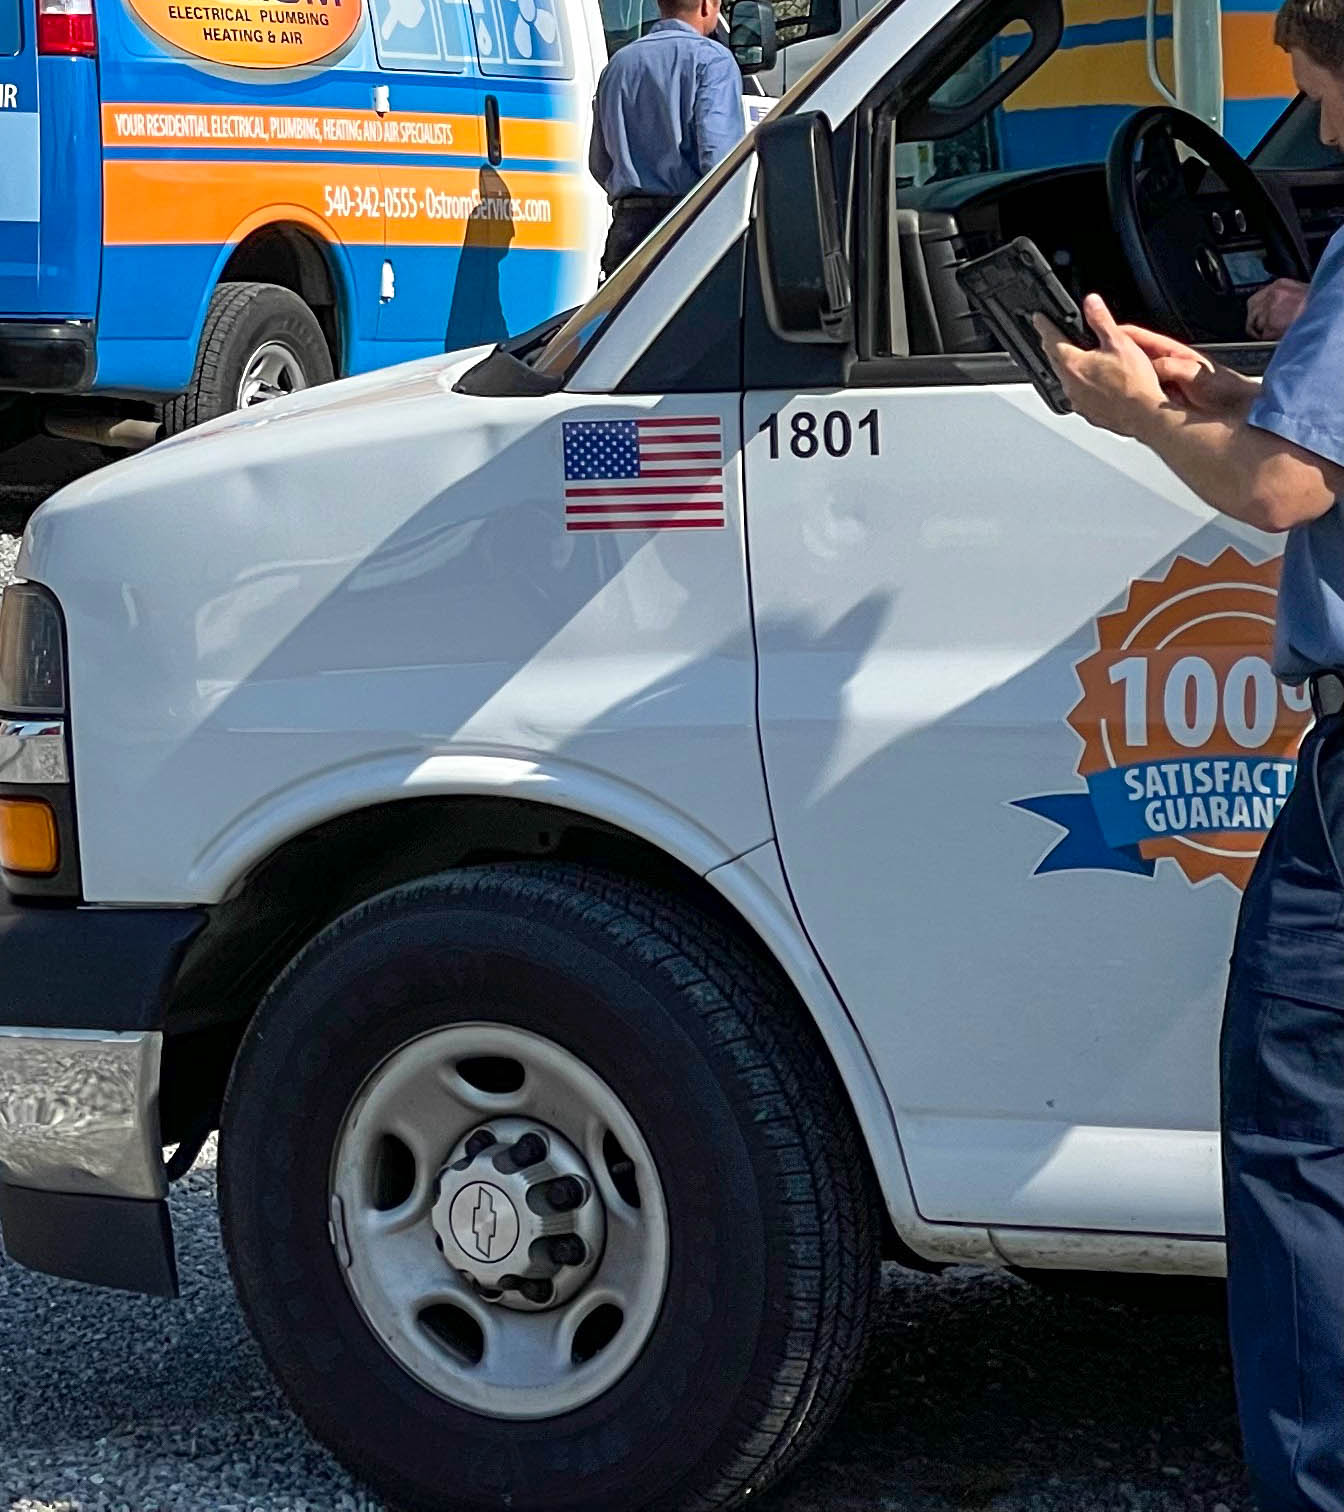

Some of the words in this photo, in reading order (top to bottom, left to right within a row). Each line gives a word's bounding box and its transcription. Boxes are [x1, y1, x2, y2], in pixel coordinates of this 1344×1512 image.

[168, 5, 252, 22] ELECTRICAL
[260, 9, 329, 26] PLUMBING
[203, 28, 263, 43] HEATING
[267, 30, 276, 43] &
[280, 31, 303, 44] AIR
[115, 114, 145, 136] YOUR
[146, 114, 210, 137] RESIDENTIAL
[211, 116, 269, 141] ELECTRICAL,
[270, 117, 322, 143] PLUMBING,
[323, 118, 362, 141] HEATING
[363, 120, 383, 142] AND
[384, 120, 399, 142] AIR
[400, 122, 453, 145] SPECIALISTS
[324, 185, 418, 217] 540-342-0555
[425, 187, 552, 223] OstromServices.com
[759, 408, 880, 459] 1801
[1108, 655, 1312, 749] 100
[1124, 760, 1297, 801] SATISFACT
